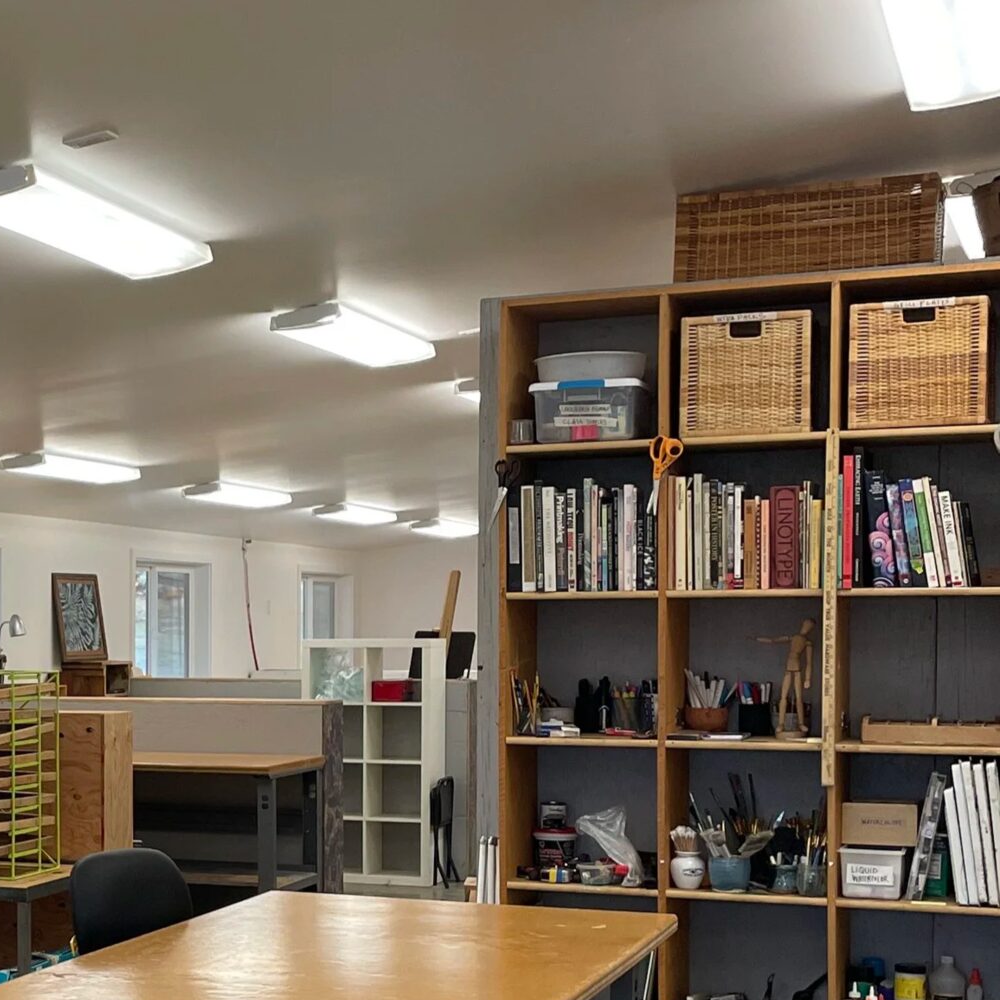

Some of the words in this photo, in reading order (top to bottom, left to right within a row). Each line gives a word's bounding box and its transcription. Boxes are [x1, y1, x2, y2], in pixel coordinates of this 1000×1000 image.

[556, 495, 565, 544] Printmaking
[941, 495, 950, 520] MAKE
[777, 497, 793, 580] LINOTYPE
[944, 521, 953, 536] INK
[850, 866, 879, 874] LIQUID
